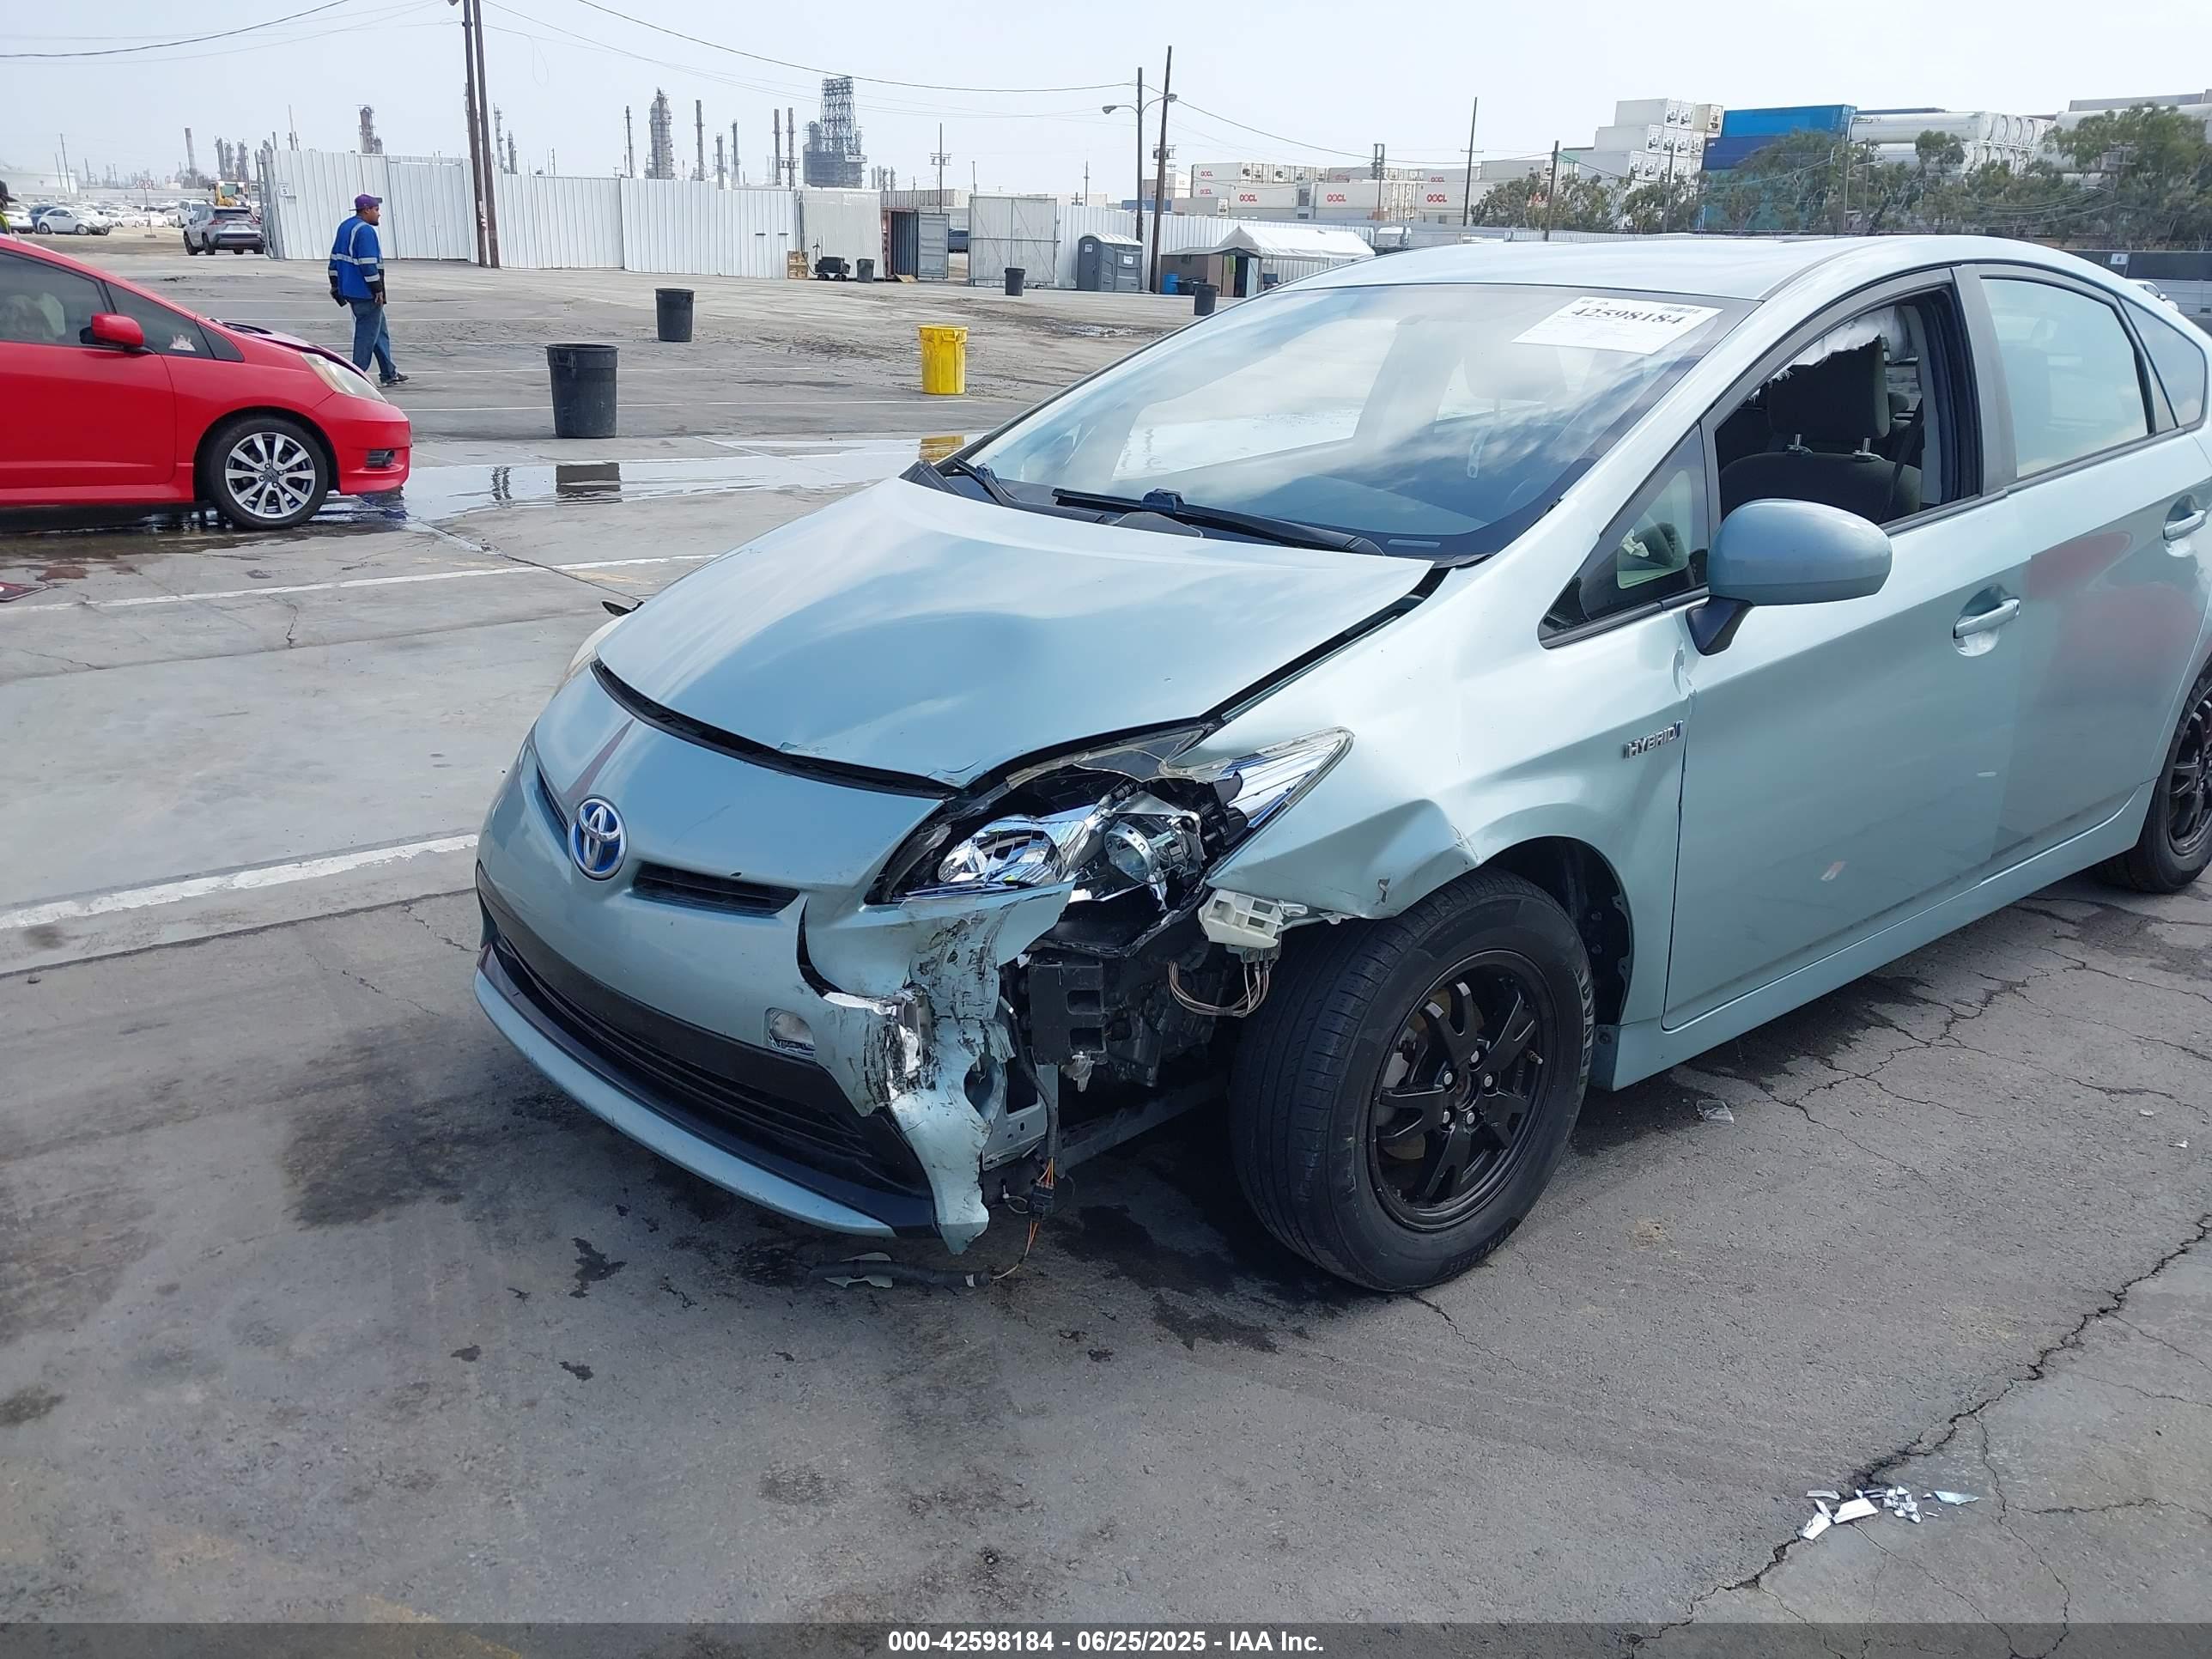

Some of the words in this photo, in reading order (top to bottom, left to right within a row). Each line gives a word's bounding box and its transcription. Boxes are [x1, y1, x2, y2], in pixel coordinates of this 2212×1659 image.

[1239, 194, 1258, 203] OOCL
[1571, 307, 1686, 324] 42598184
[1625, 723, 1680, 759] HYBRID
